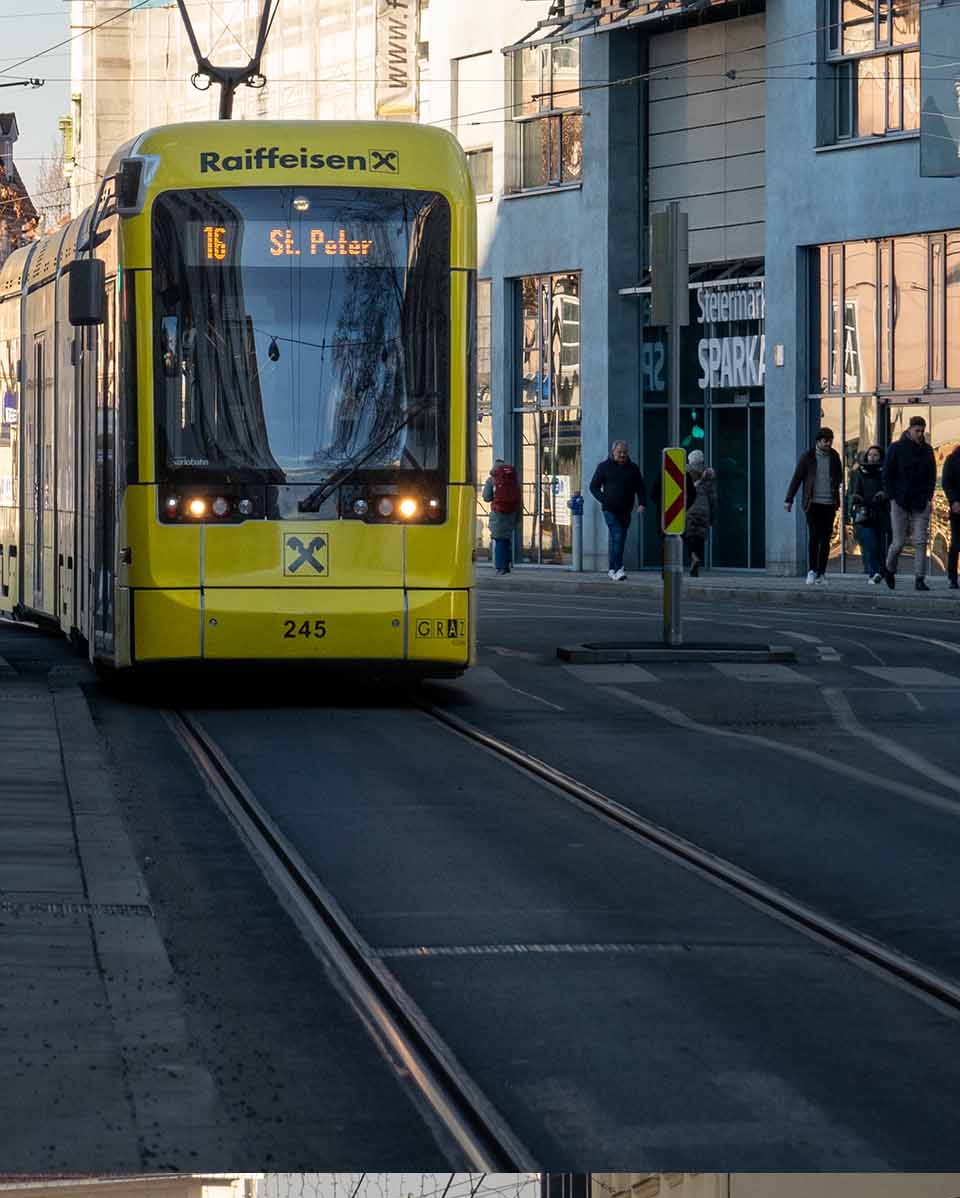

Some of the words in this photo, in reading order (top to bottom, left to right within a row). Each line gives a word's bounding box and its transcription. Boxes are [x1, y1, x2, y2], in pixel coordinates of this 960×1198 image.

[200, 147, 367, 173] Raiffeisen
[203, 226, 226, 260] 16
[270, 229, 300, 256] St.
[310, 229, 372, 256] Peter
[283, 620, 326, 638] 245
